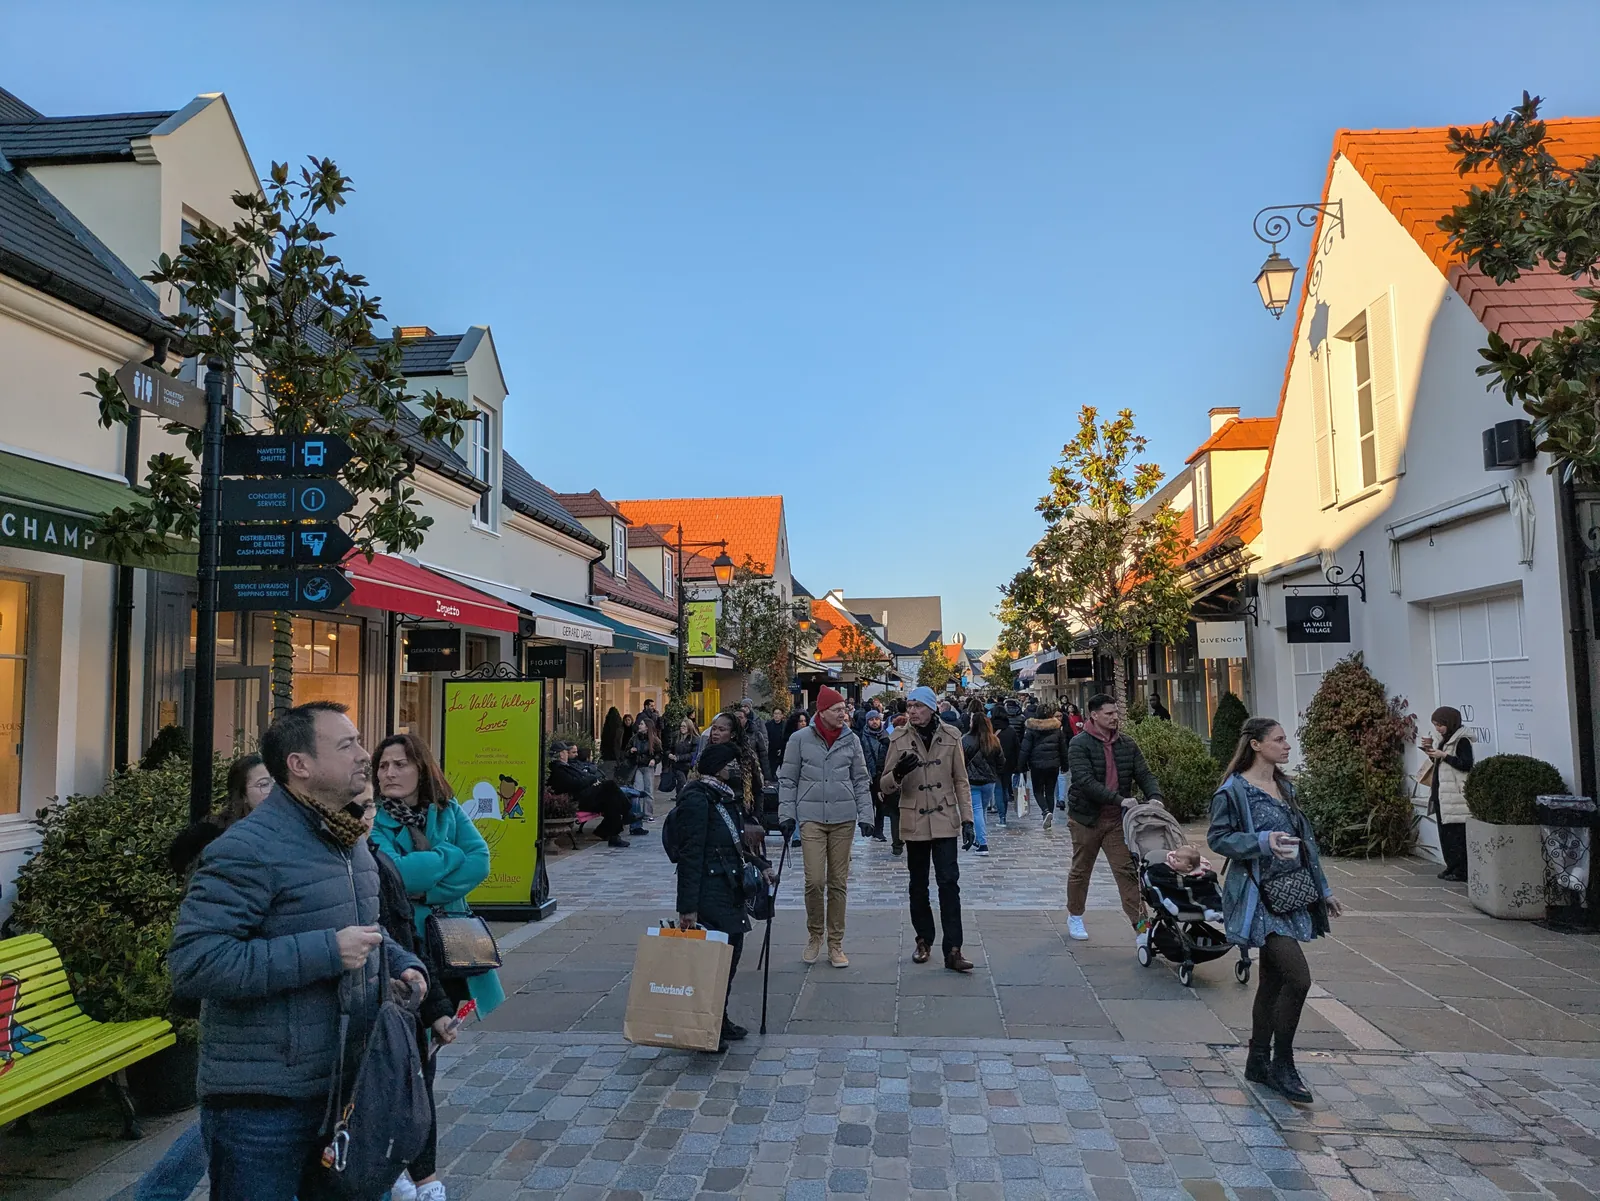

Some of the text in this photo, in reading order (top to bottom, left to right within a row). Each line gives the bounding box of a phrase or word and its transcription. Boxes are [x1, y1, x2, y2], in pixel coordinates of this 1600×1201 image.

[163, 396, 180, 408] TOILETS
[562, 626, 593, 641] GERARD DAREL
[448, 690, 536, 712] La Vallée Village
[476, 711, 508, 732] Loves
[494, 872, 521, 884] Village
[649, 982, 684, 996] Timberland
